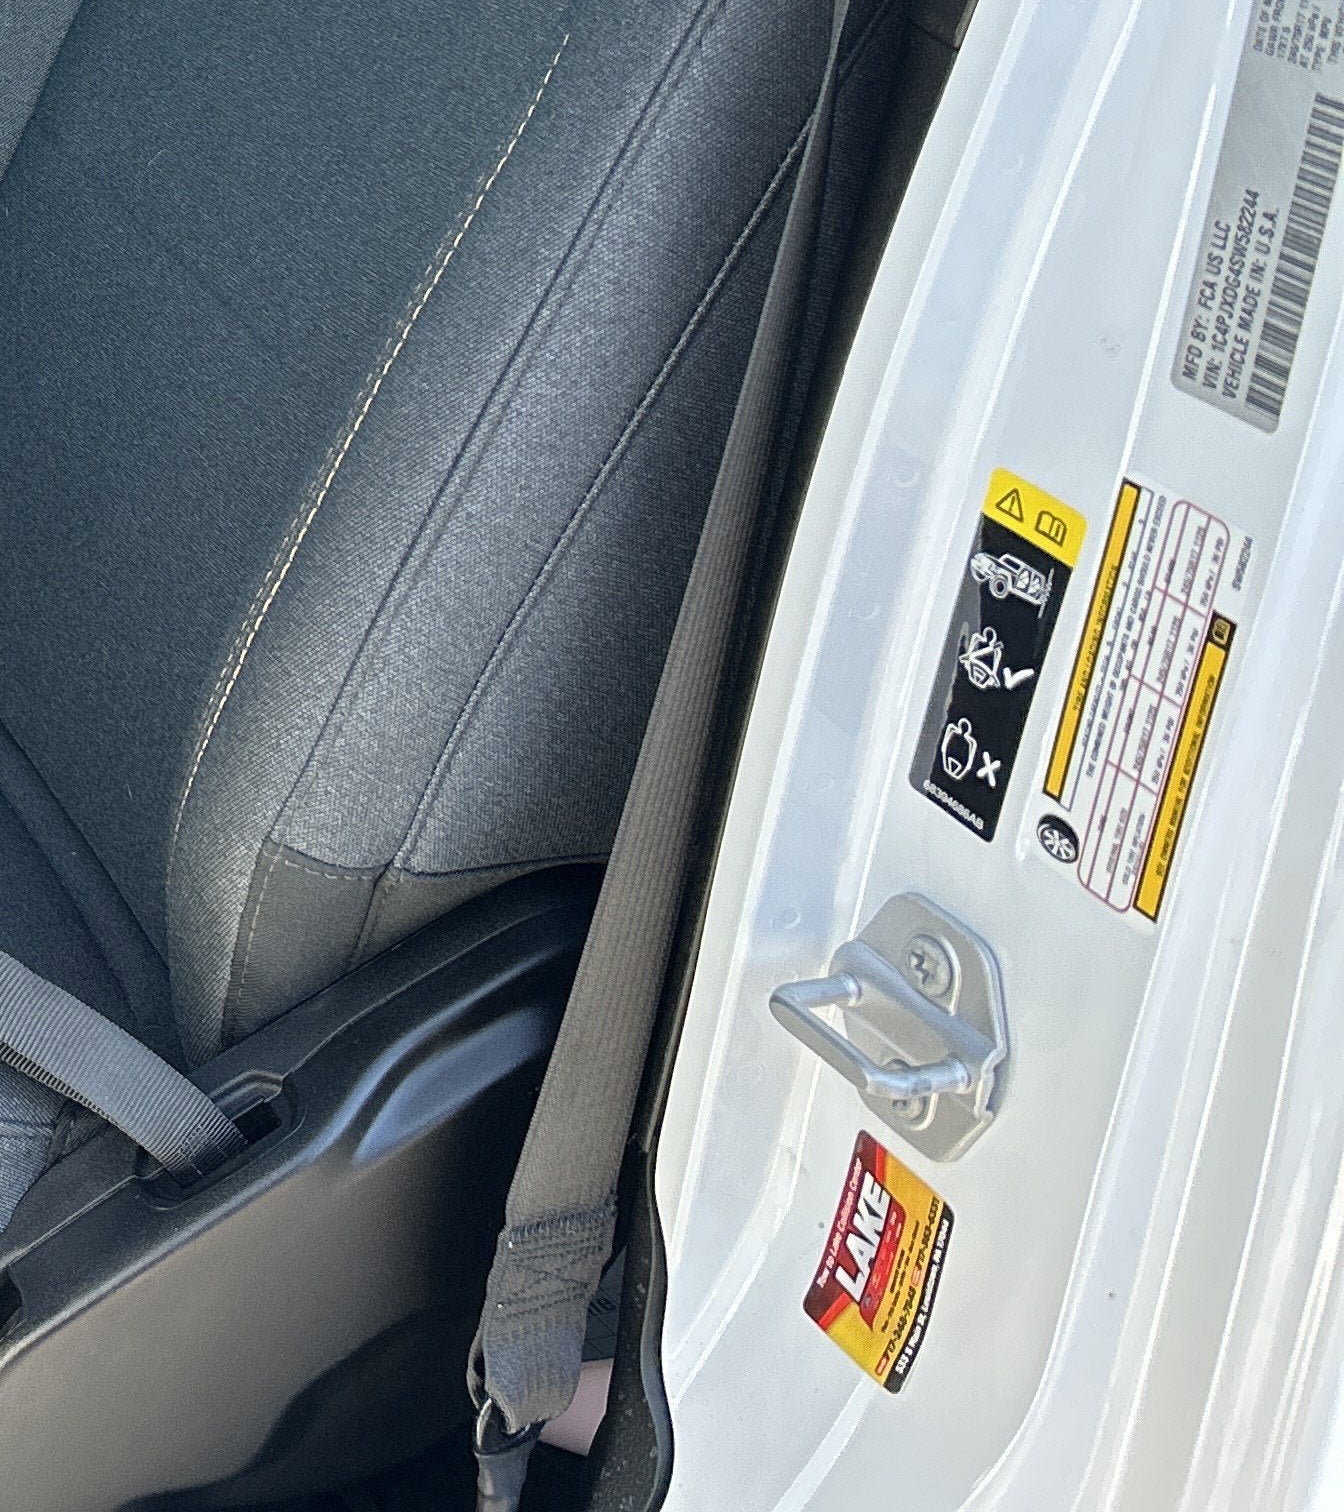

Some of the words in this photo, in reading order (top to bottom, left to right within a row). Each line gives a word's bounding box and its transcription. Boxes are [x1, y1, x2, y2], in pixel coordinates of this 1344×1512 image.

[1210, 219, 1230, 250] LLC
[1255, 204, 1279, 255] U.S.A.
[1205, 251, 1223, 276] US
[1248, 258, 1266, 281] IN:
[1198, 277, 1217, 310] FCA
[1236, 284, 1260, 332] MADE
[1191, 313, 1209, 342] BY:
[1181, 343, 1202, 380] MFD
[1202, 357, 1221, 389] VIN:
[1221, 334, 1249, 398] VEHICLE
[835, 1171, 892, 1302] LAKE
